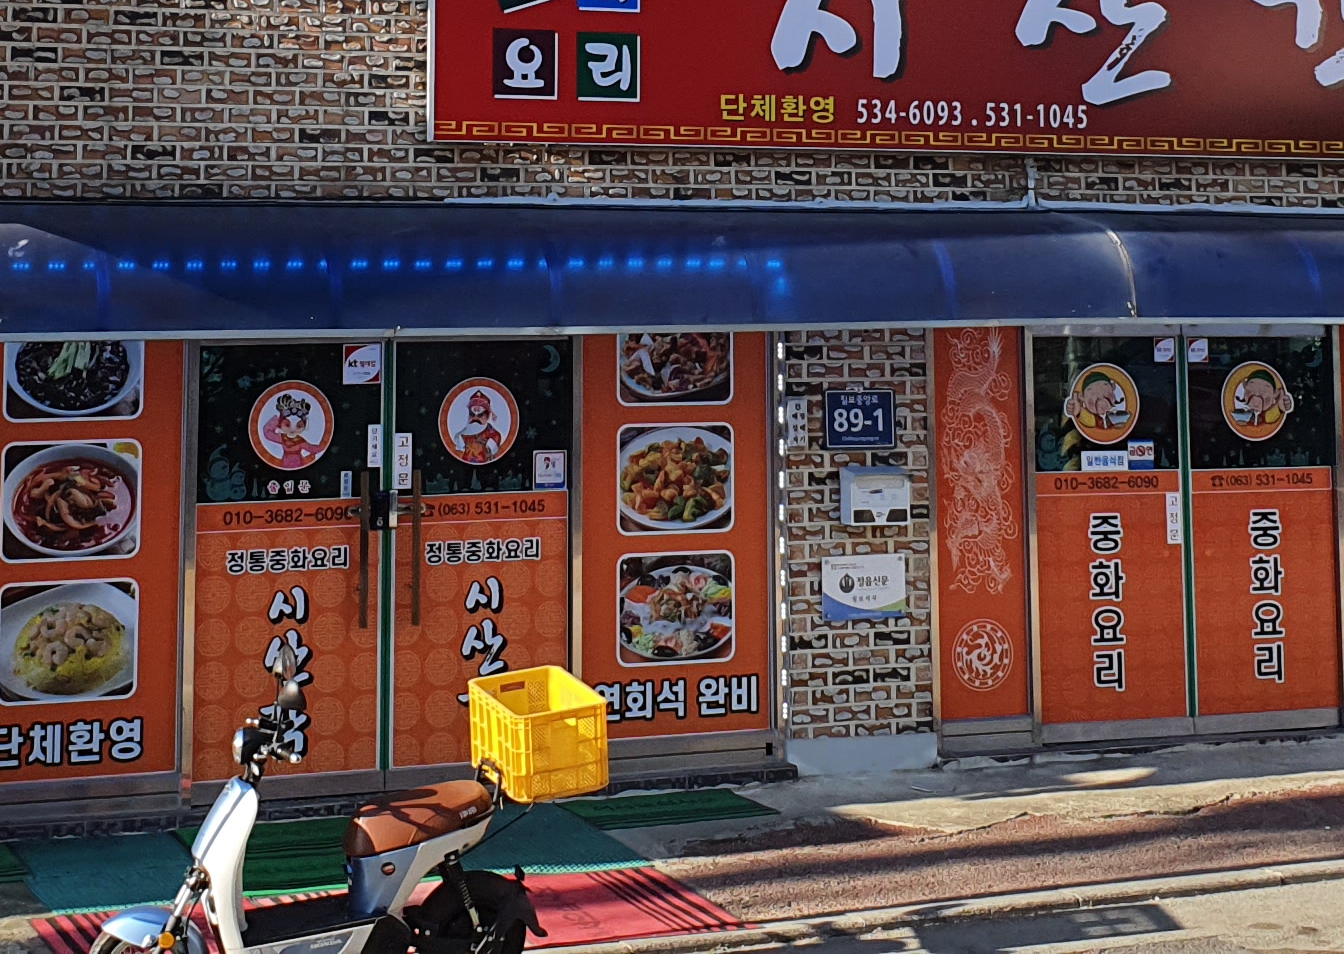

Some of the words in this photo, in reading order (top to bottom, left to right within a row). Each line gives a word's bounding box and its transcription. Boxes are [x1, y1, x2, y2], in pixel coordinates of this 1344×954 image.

[720, 92, 837, 124] 단체환영
[856, 98, 963, 126] 534-6093
[985, 101, 1089, 130] 531-1045
[834, 408, 883, 432] 89-1
[398, 436, 409, 486] 고정문
[1054, 476, 1159, 490] 010-3682-6090
[1226, 474, 1252, 487] (063)
[1256, 472, 1313, 486] 531-1045
[438, 502, 470, 516] (063)
[474, 499, 545, 514] 531-1045
[226, 546, 350, 575] 정통중화요리
[425, 537, 541, 565] 정통중화요리
[1088, 513, 1126, 691] 중화요리
[1249, 509, 1284, 683] 중화요리
[457, 576, 507, 702] 시산
[698, 676, 759, 714] 완비
